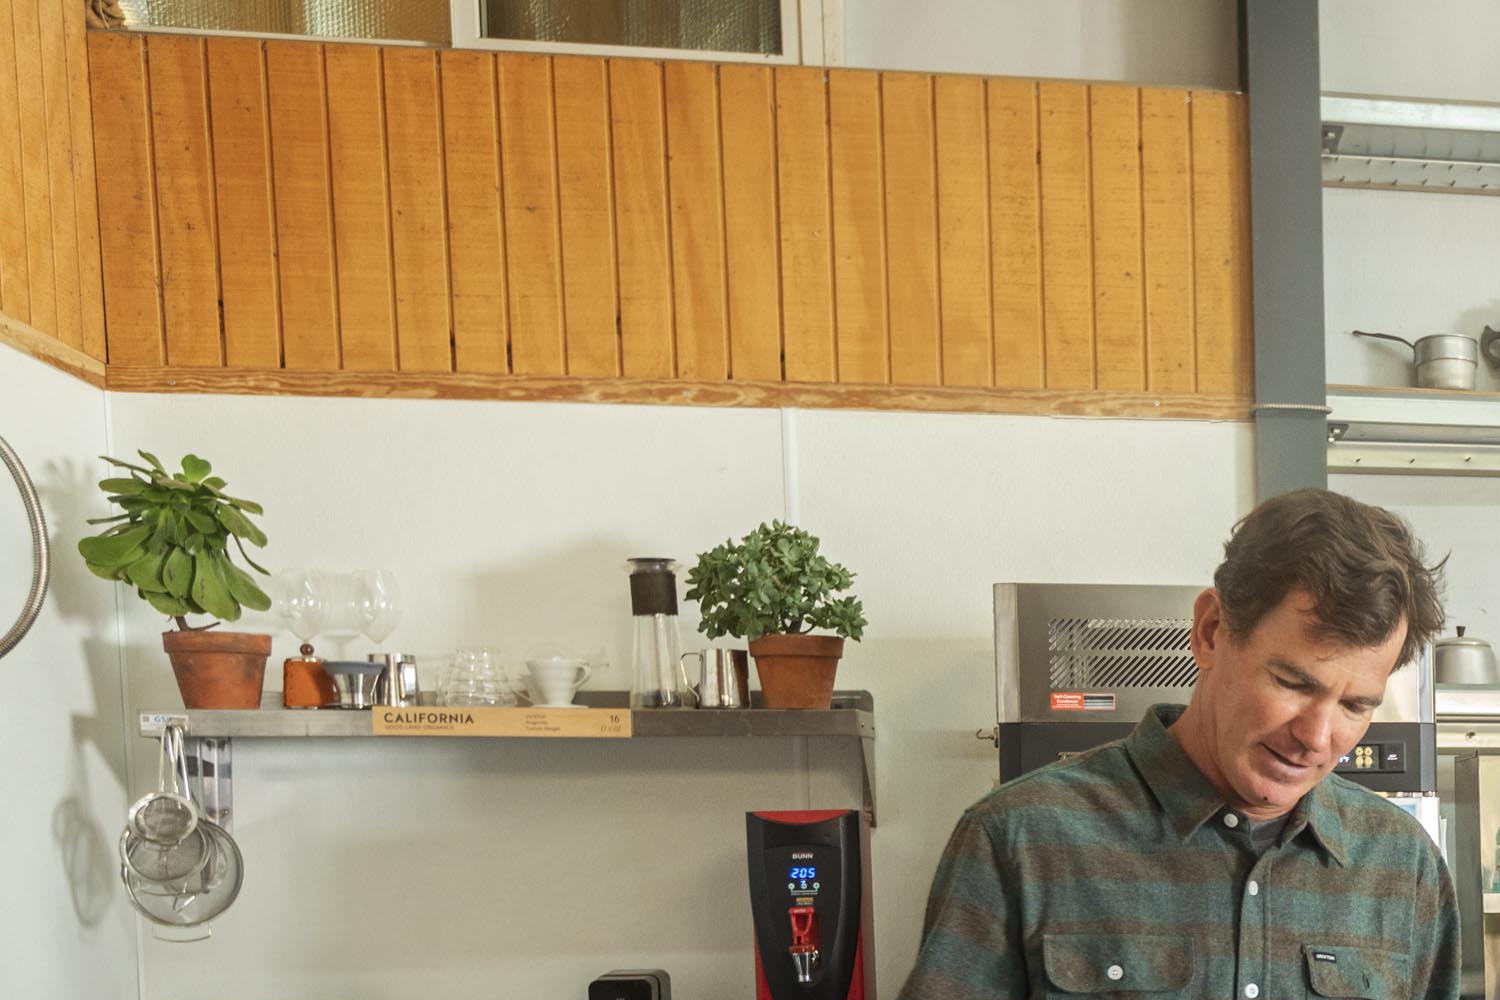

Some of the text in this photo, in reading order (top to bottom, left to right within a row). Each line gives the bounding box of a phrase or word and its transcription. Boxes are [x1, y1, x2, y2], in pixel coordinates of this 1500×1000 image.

[383, 712, 474, 725] CALIFORNIA
[610, 715, 620, 724] 16
[790, 867, 816, 879] 205
